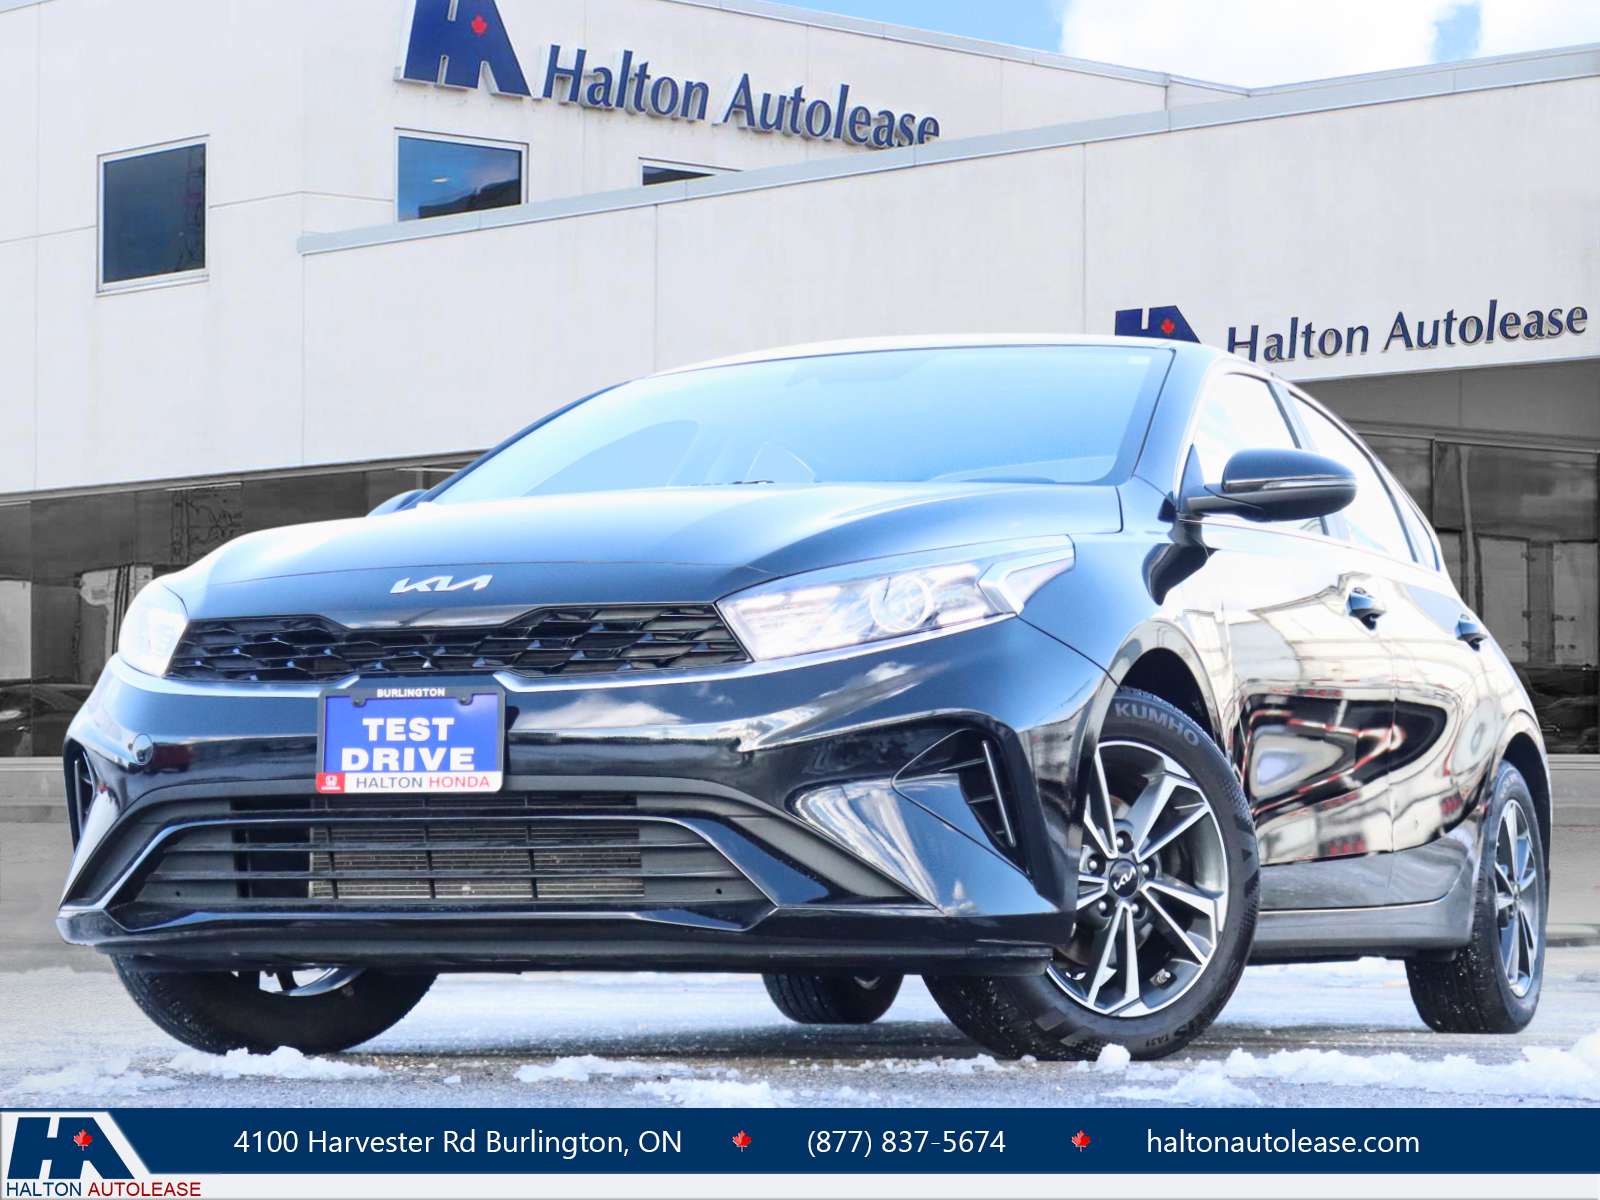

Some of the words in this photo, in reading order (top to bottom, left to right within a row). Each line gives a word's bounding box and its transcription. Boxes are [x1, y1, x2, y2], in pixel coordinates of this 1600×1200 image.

[542, 44, 709, 120] Halton
[722, 73, 940, 147] Autolease
[1227, 316, 1369, 363] Halton
[1385, 299, 1588, 352] Autolease
[390, 574, 493, 594] KIA
[376, 687, 446, 699] BURLINGTON
[362, 717, 455, 742] TEST
[1114, 702, 1200, 747] KUMHO
[341, 747, 476, 772] DRIVE
[355, 776, 423, 789] HALTON
[429, 775, 491, 788] HONDA
